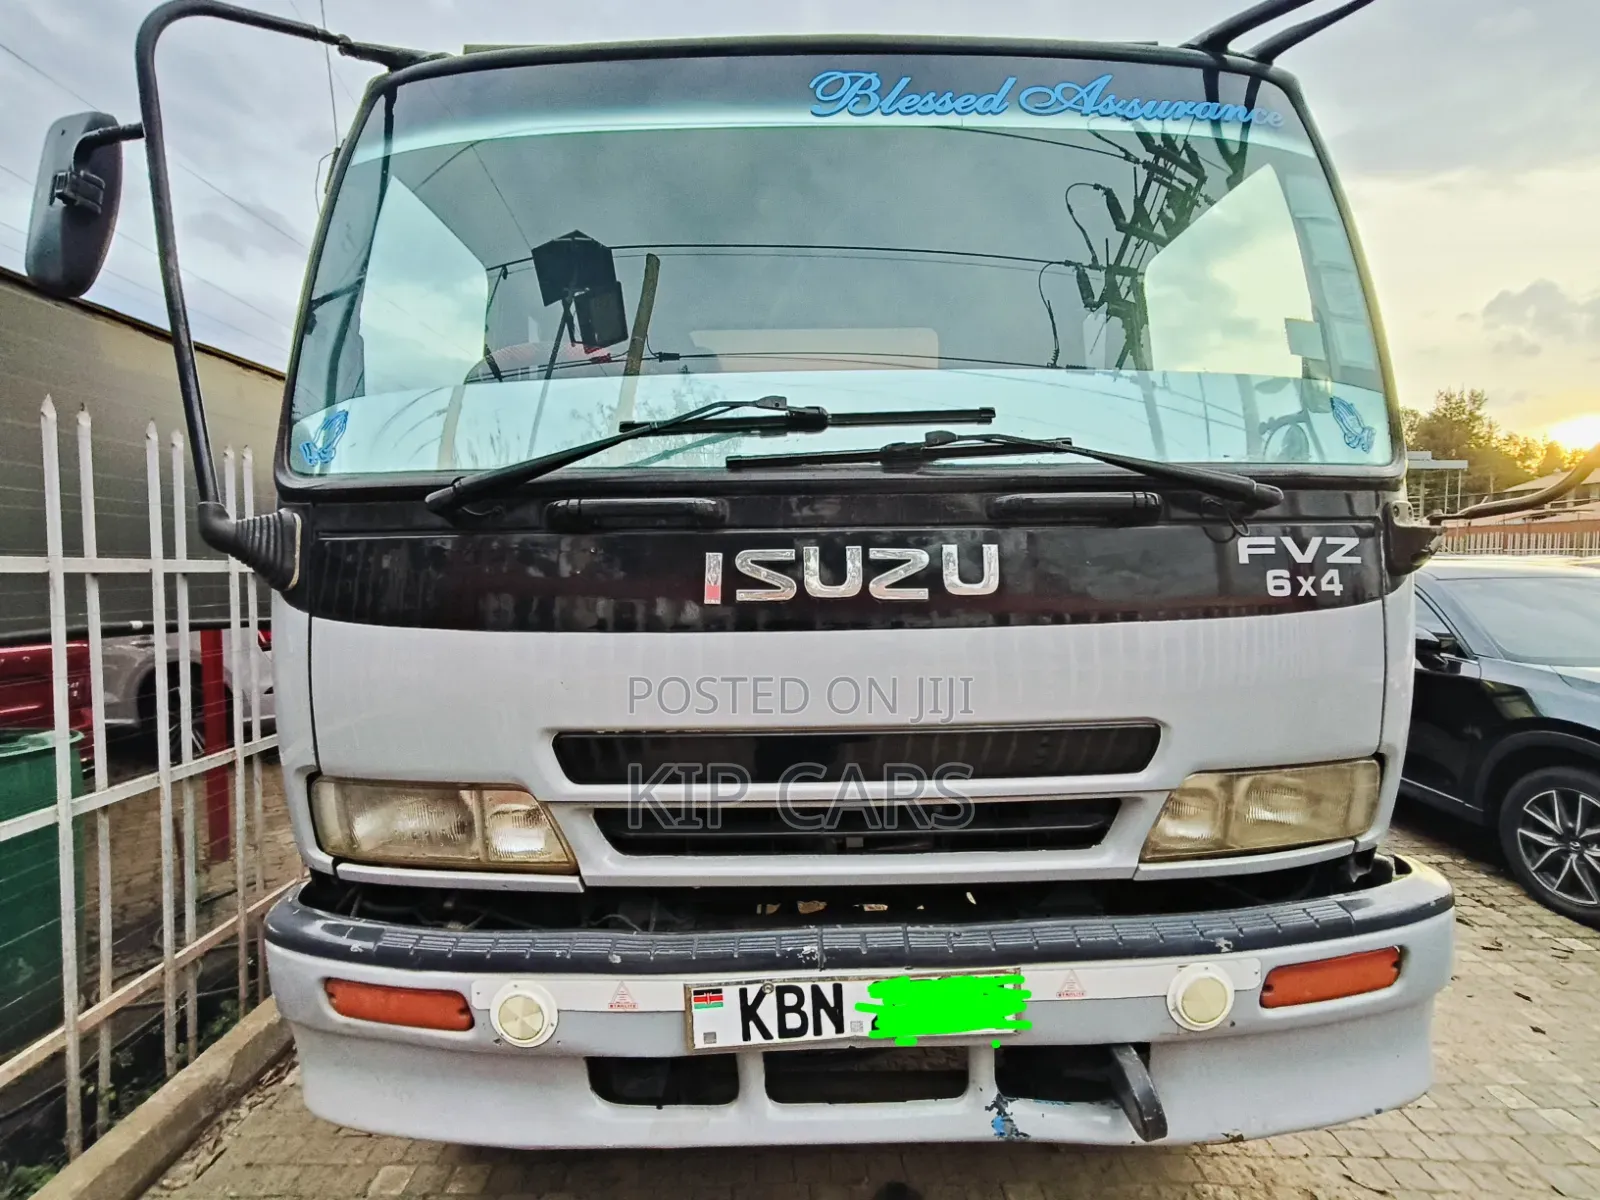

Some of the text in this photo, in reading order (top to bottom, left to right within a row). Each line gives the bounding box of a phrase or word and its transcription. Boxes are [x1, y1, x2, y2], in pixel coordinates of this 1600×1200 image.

[809, 71, 1285, 127] Blessed Assurance
[703, 543, 1000, 605] ISUZU
[1237, 536, 1362, 565] FVZ
[1265, 568, 1344, 598] 6x4
[738, 983, 845, 1042] KBN
